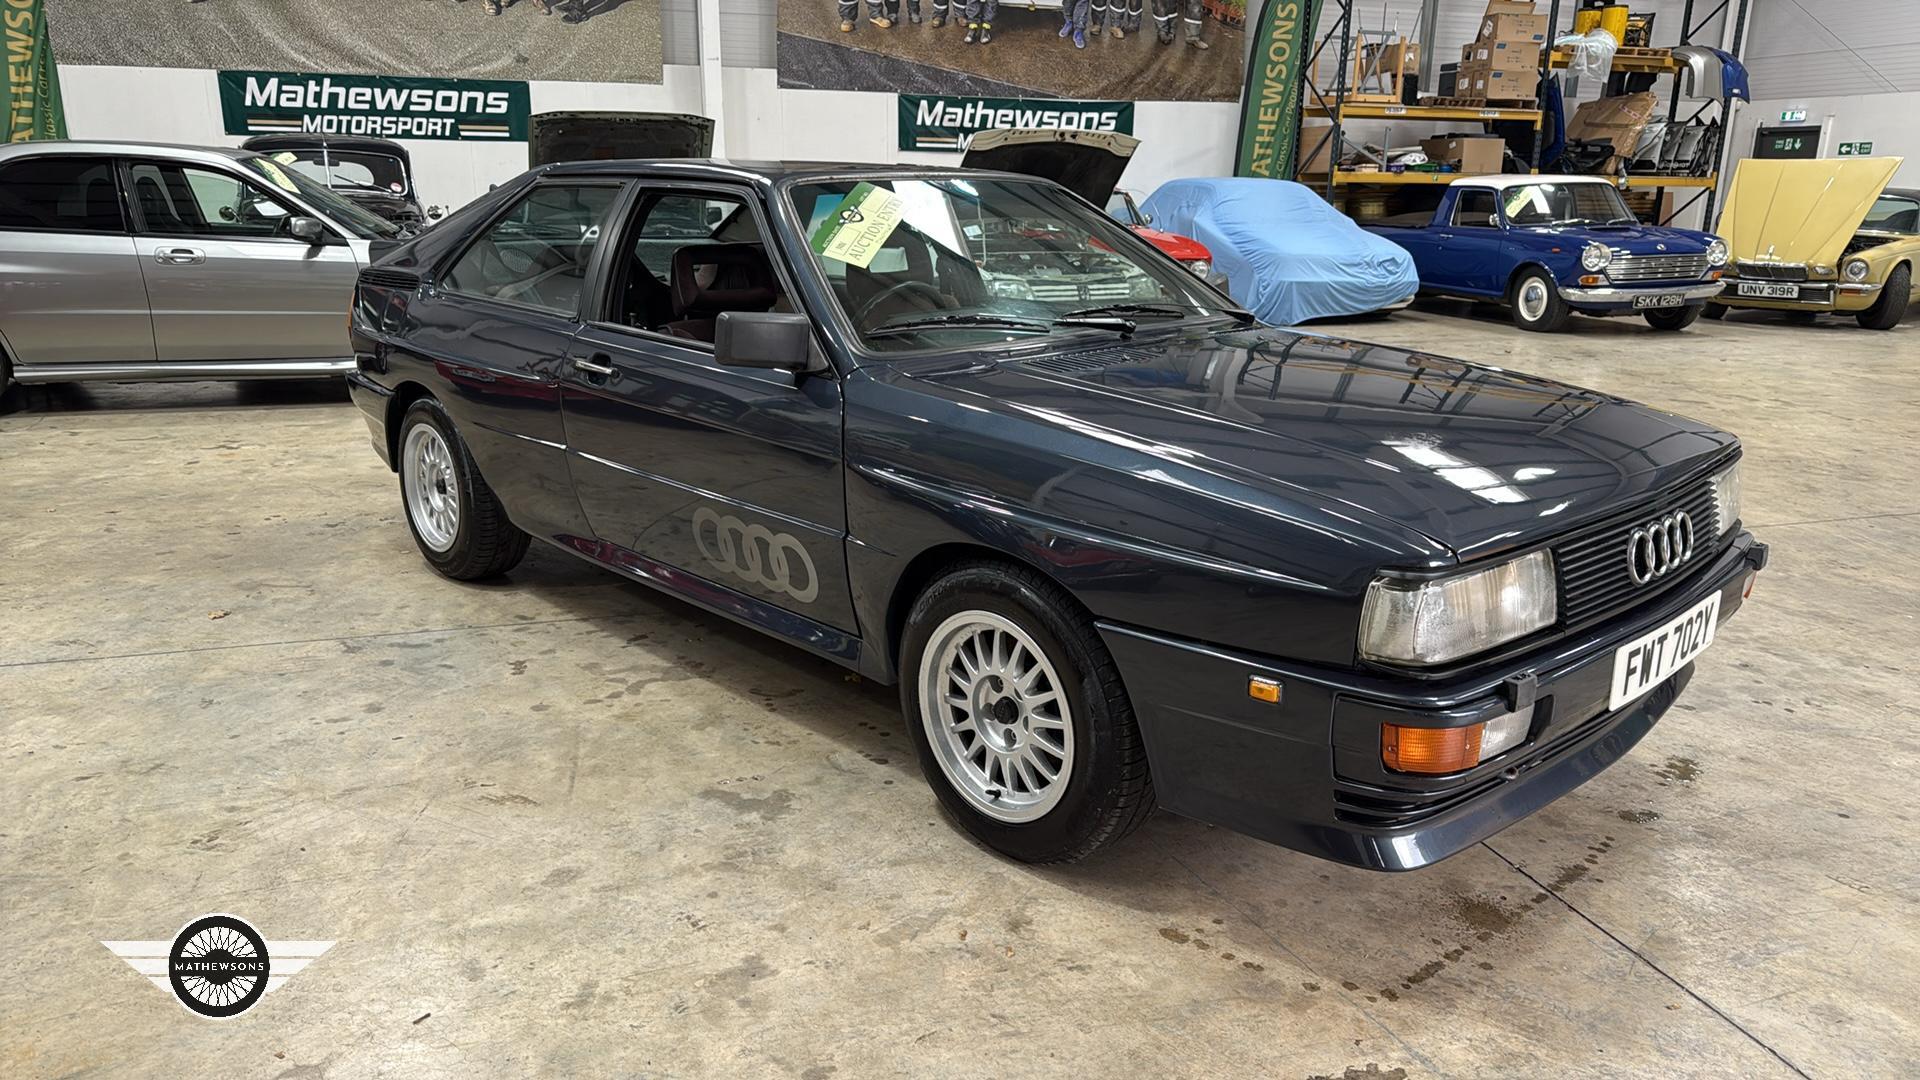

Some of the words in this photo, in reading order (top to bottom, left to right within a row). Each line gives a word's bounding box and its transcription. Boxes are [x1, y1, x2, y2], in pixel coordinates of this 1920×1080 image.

[244, 76, 510, 113] Mathewsons
[1252, 2, 1298, 177] ATHEWSONS
[41, 101, 57, 140] lassic
[302, 114, 455, 136] MOTORSPORT
[916, 100, 1118, 130] Mathewsons
[849, 219, 885, 260] AUCTION
[1636, 295, 1660, 307] SKK
[1659, 295, 1682, 306] 128H
[1741, 284, 1765, 295] UNV
[1767, 285, 1794, 296] 319R
[1623, 632, 1669, 697] FWT
[1670, 601, 1714, 668] 702Y
